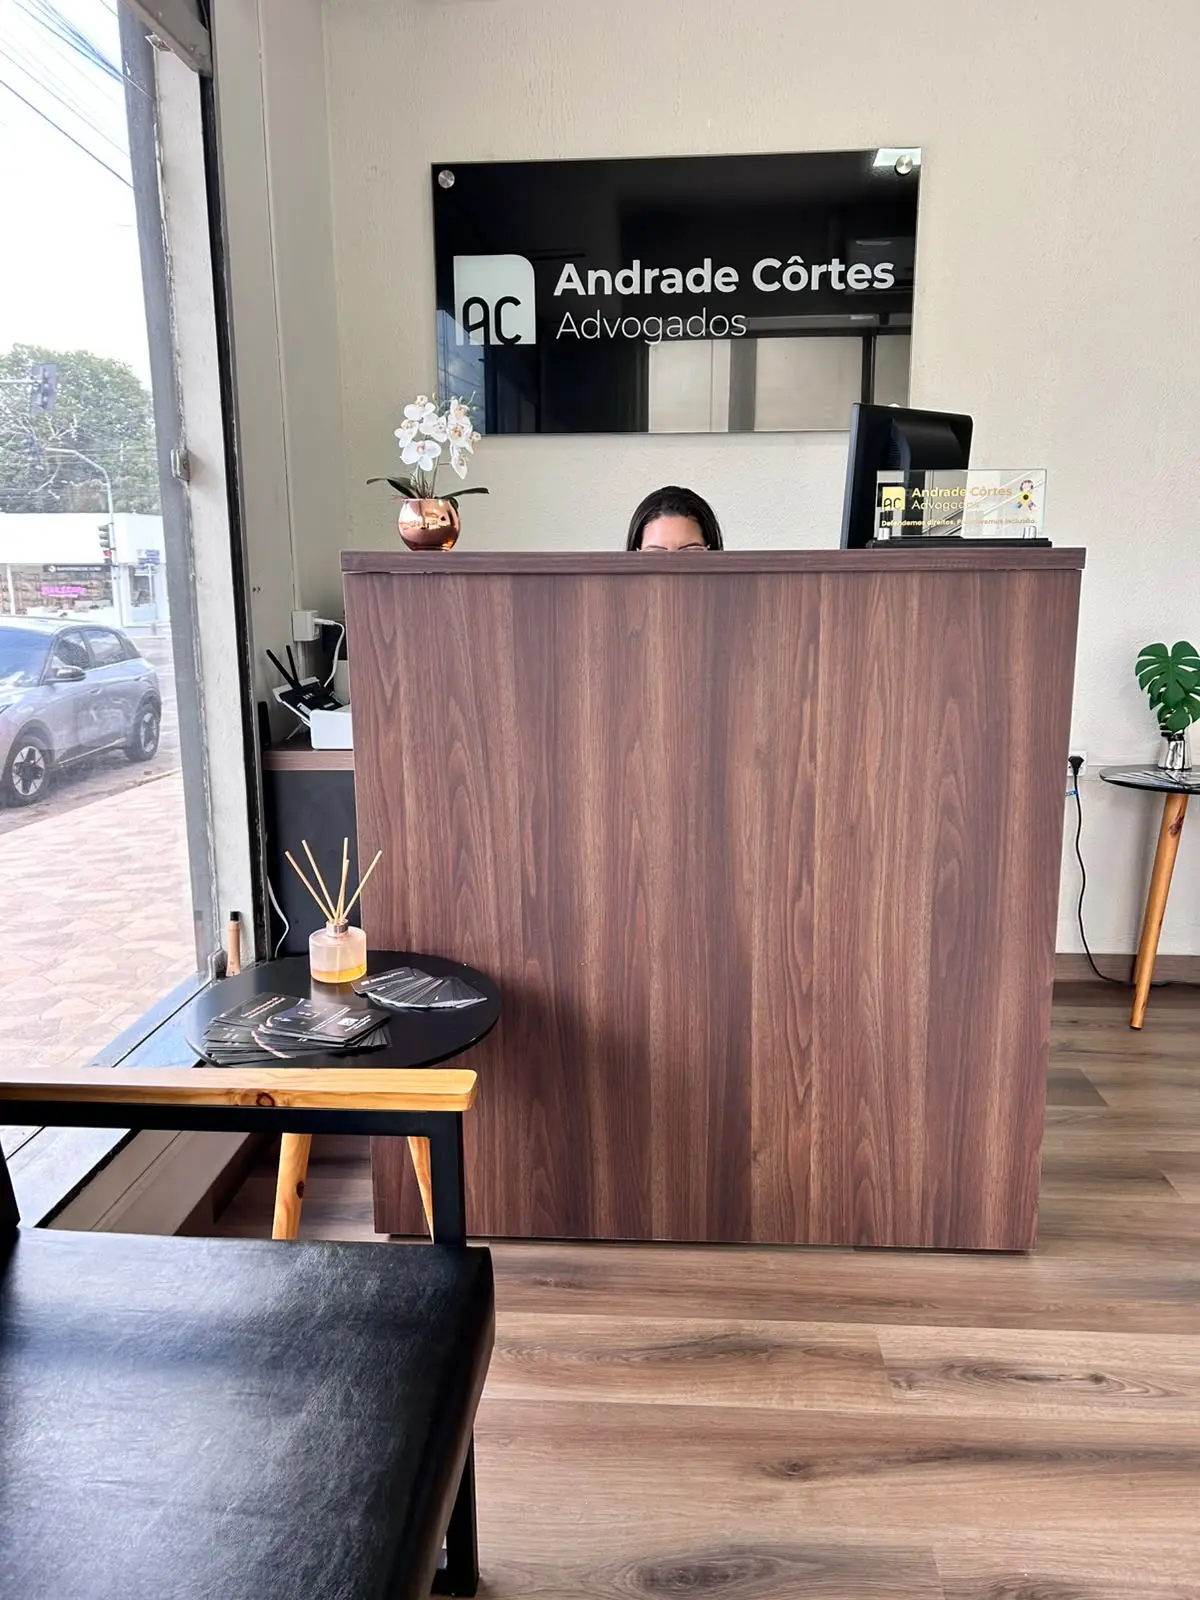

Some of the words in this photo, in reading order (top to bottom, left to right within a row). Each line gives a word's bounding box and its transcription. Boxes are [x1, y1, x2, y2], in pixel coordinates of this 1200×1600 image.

[553, 260, 739, 297] Andrade
[752, 255, 896, 293] Côrtes
[556, 307, 748, 346] Advogados
[912, 487, 967, 497] Andrade
[970, 486, 1012, 497] Côrtes
[912, 499, 980, 511] Advogad
